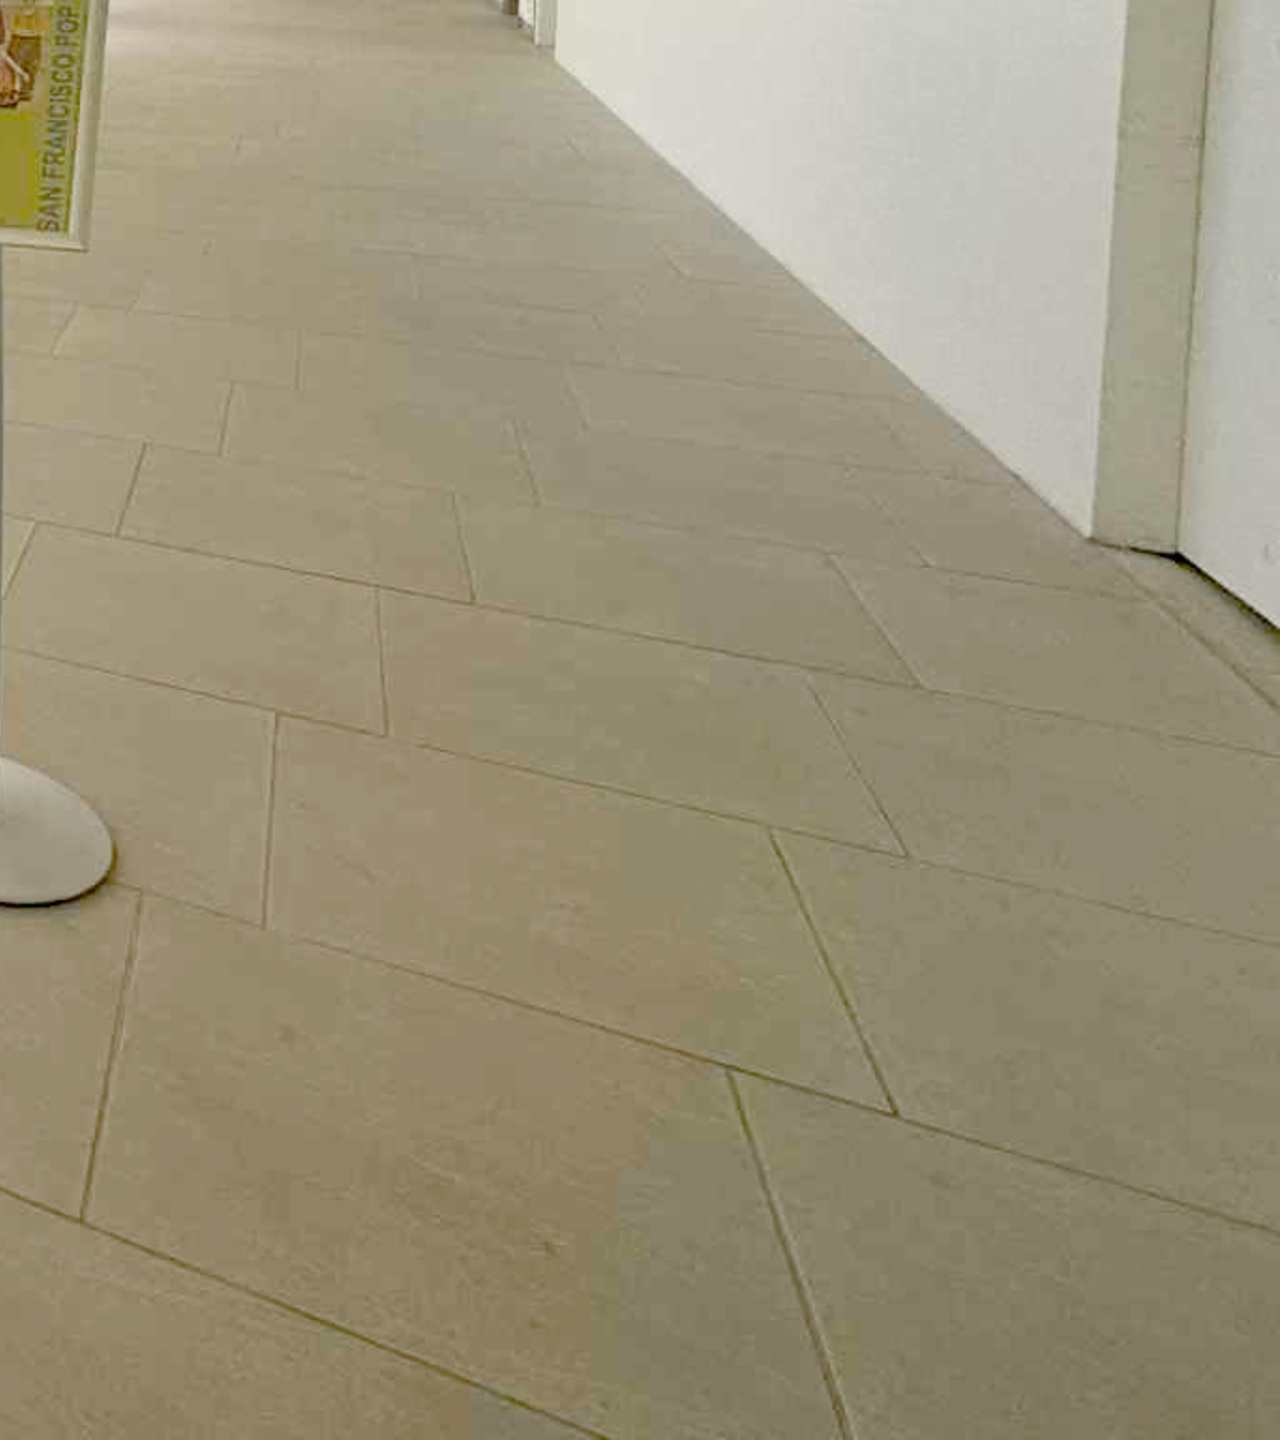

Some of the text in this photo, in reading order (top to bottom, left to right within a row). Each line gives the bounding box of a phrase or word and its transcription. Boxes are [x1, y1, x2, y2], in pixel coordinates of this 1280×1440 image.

[55, 6, 81, 47] POP
[42, 54, 75, 179] FRANCISCO
[36, 185, 63, 233] SAN
